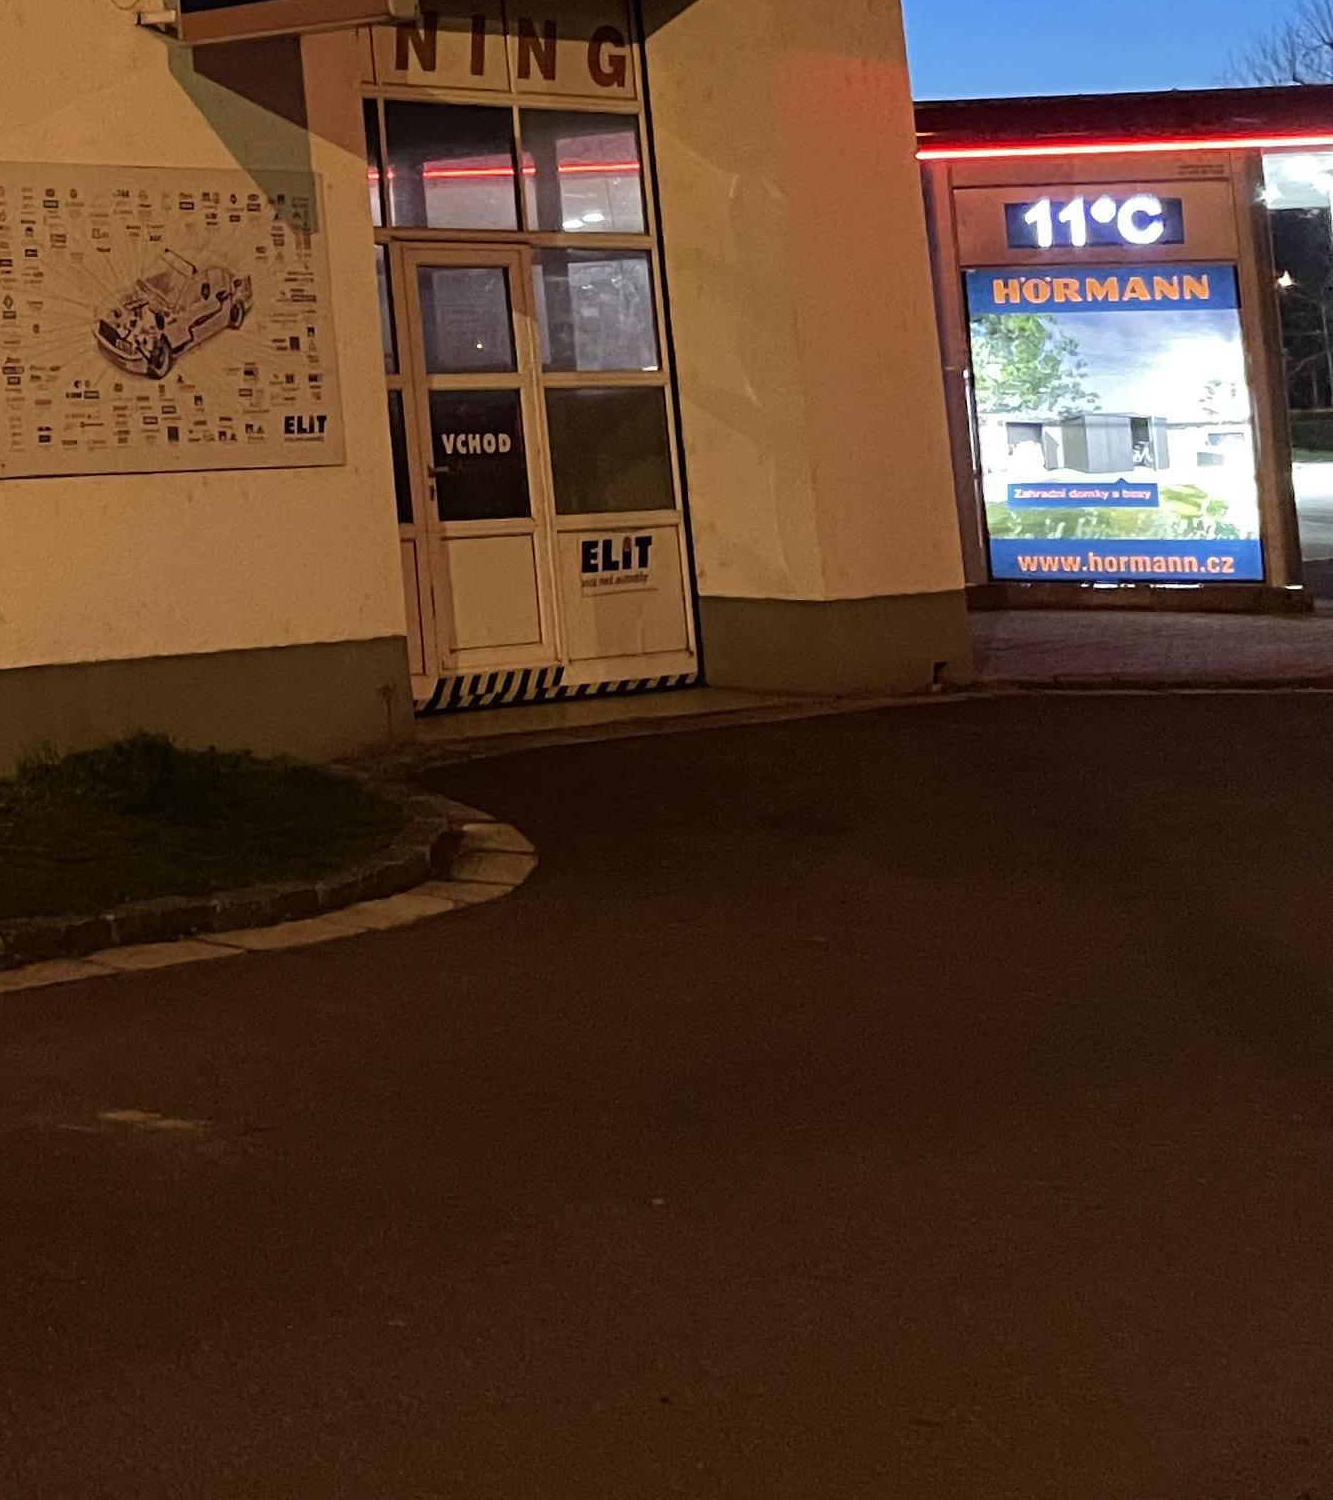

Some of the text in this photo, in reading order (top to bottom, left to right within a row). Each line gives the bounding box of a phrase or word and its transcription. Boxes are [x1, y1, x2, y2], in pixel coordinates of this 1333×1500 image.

[1025, 195, 1164, 248] 11°C
[441, 433, 511, 454] VCHOD
[1018, 552, 1235, 573] www.hormann.cz
